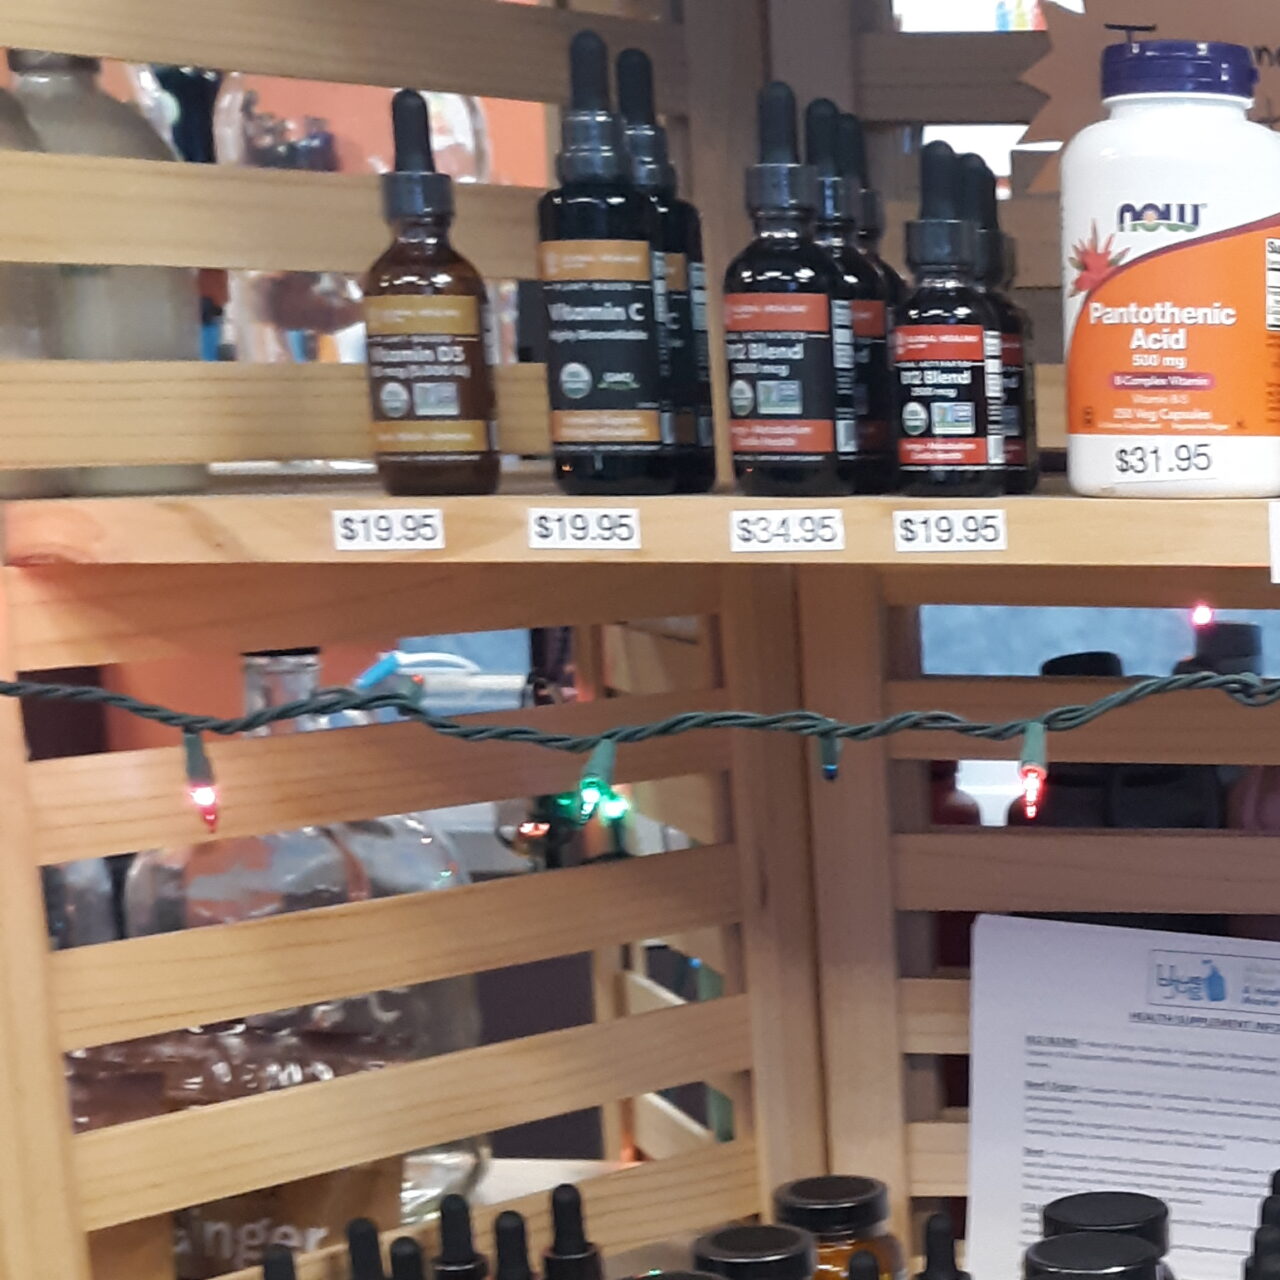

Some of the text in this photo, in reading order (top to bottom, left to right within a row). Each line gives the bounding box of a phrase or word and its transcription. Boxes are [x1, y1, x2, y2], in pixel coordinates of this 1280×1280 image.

[628, 303, 645, 321] C
[1089, 302, 1237, 325] Pantothenic
[1130, 328, 1186, 350] Acid
[1162, 356, 1187, 369] mg
[1115, 443, 1213, 474] $31.95
[340, 514, 438, 541] $19.95
[534, 514, 635, 541] $19.95
[736, 515, 838, 543] $34.95
[900, 515, 1000, 543] $19.95
